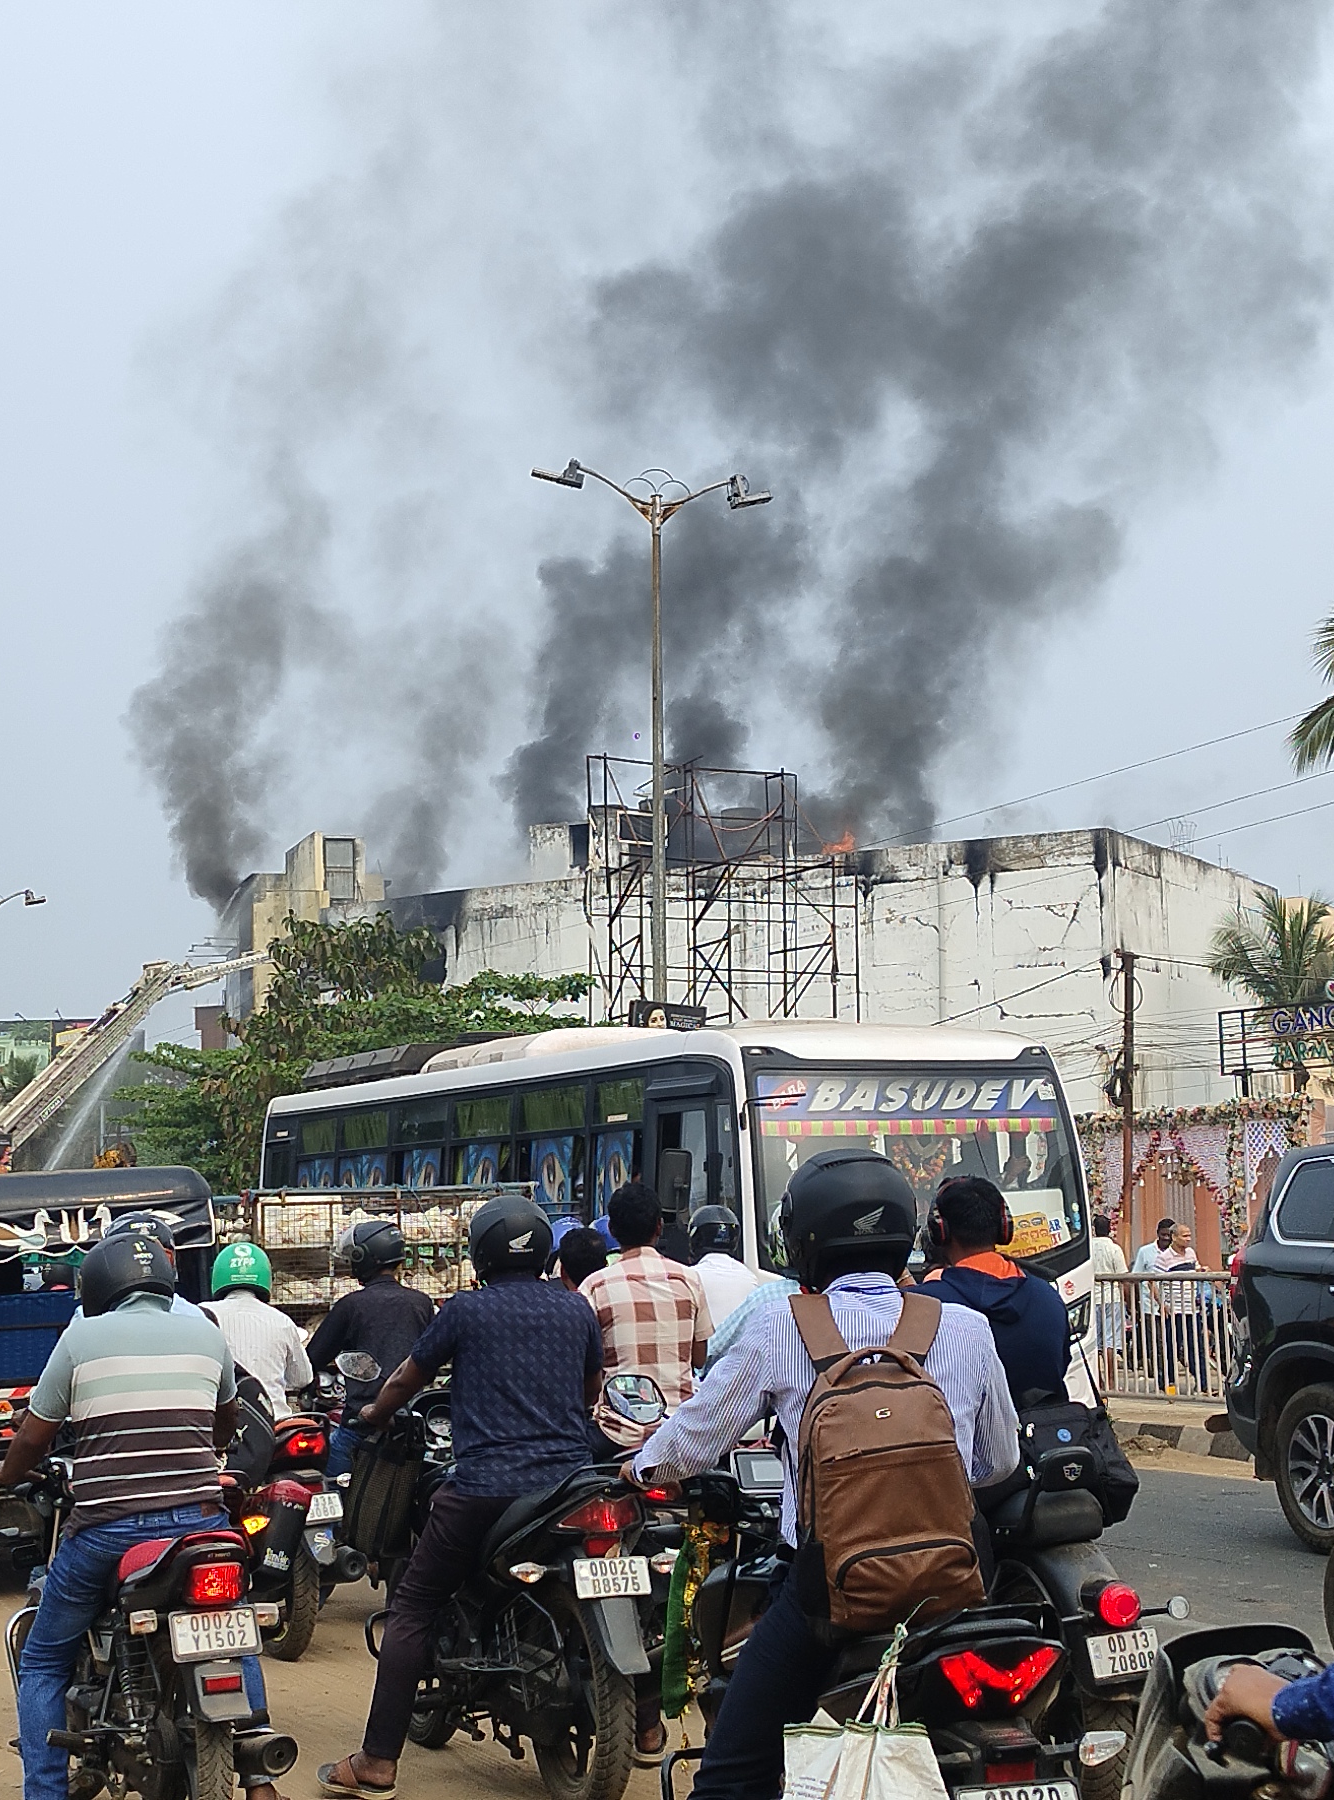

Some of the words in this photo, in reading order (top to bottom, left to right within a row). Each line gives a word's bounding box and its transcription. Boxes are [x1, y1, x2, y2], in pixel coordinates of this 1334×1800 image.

[808, 1079, 1045, 1111] BASUDEV
[230, 1257, 255, 1268] ZYPP
[190, 1612, 249, 1632] OD02C
[192, 1630, 247, 1650] Y1502
[1132, 1631, 1149, 1650] 13
